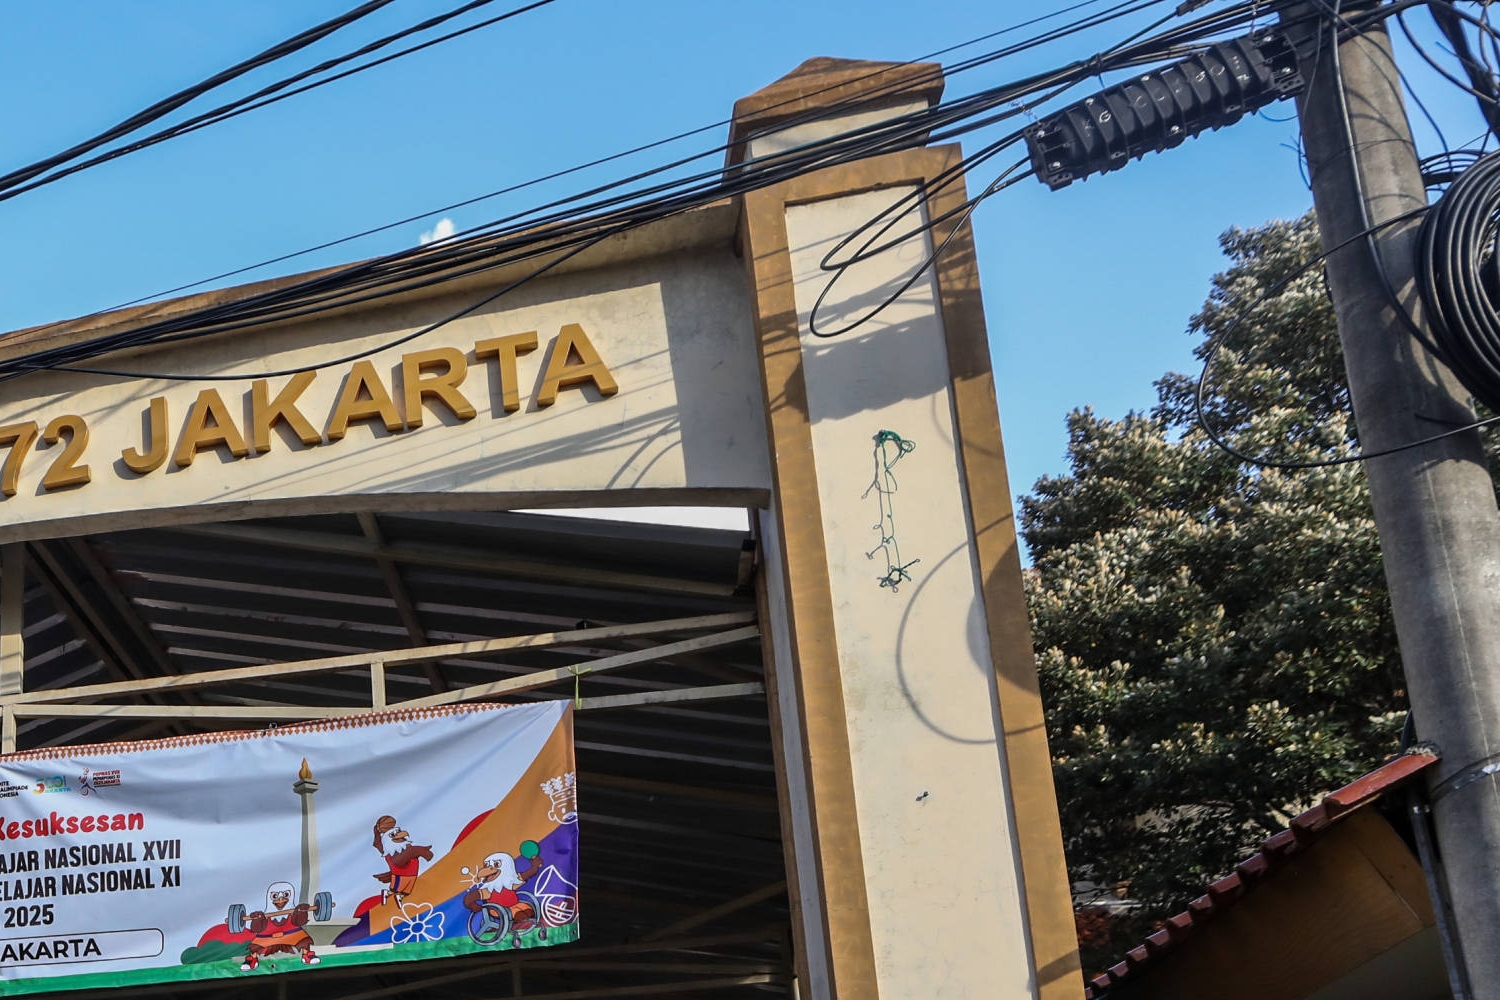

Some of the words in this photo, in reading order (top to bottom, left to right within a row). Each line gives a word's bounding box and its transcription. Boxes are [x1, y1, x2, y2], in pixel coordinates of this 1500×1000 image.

[121, 322, 619, 475] JAKARTA
[44, 843, 137, 870] NASIONAL
[143, 839, 182, 862] XVII
[61, 868, 156, 897] NASIONAL
[161, 865, 182, 888] XI
[4, 904, 55, 929] 2025
